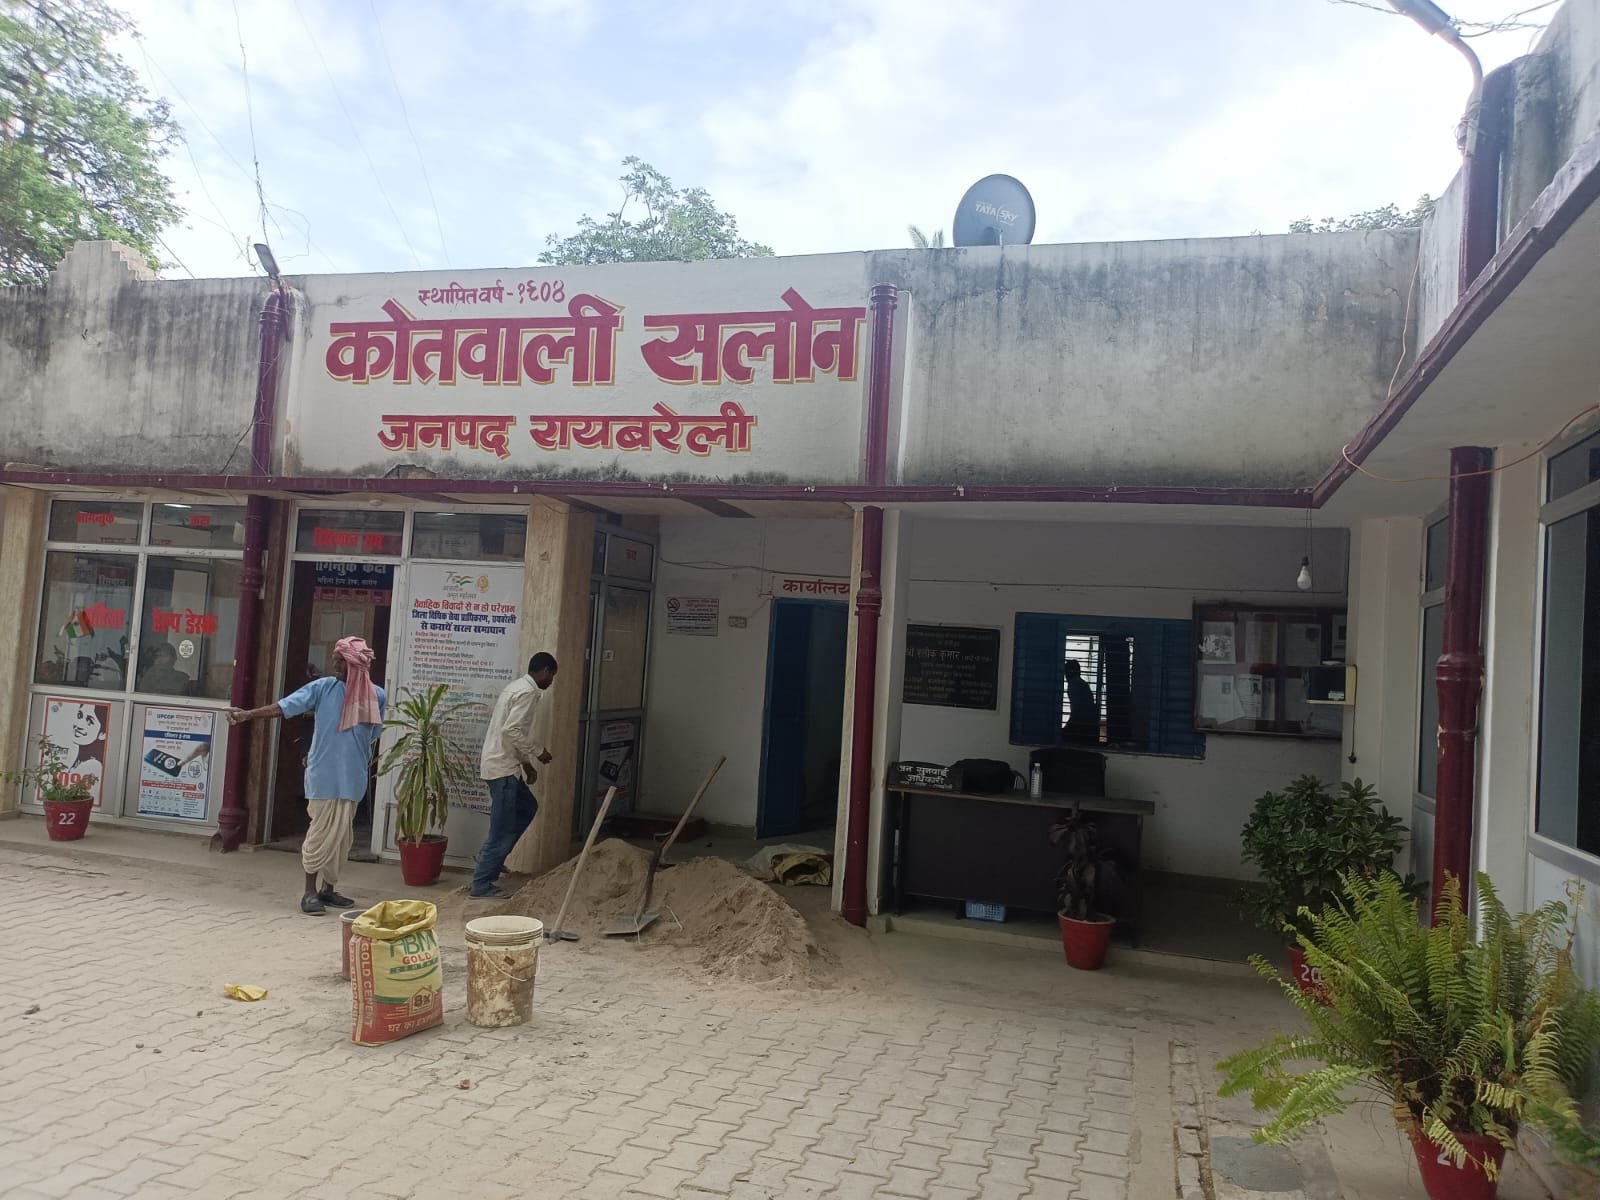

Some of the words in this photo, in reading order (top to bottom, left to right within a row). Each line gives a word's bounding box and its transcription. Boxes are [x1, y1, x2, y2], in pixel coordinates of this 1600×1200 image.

[975, 203, 996, 217] TATA
[325, 293, 624, 387] कोतवाली
[641, 287, 867, 386] सलोन
[377, 414, 516, 459] जनपद
[529, 401, 758, 457] रायबरेली
[420, 620, 429, 631] से
[58, 812, 76, 825] 22
[361, 943, 372, 976] GOLD
[402, 951, 433, 965] GOLD
[388, 1023, 403, 1033] घर
